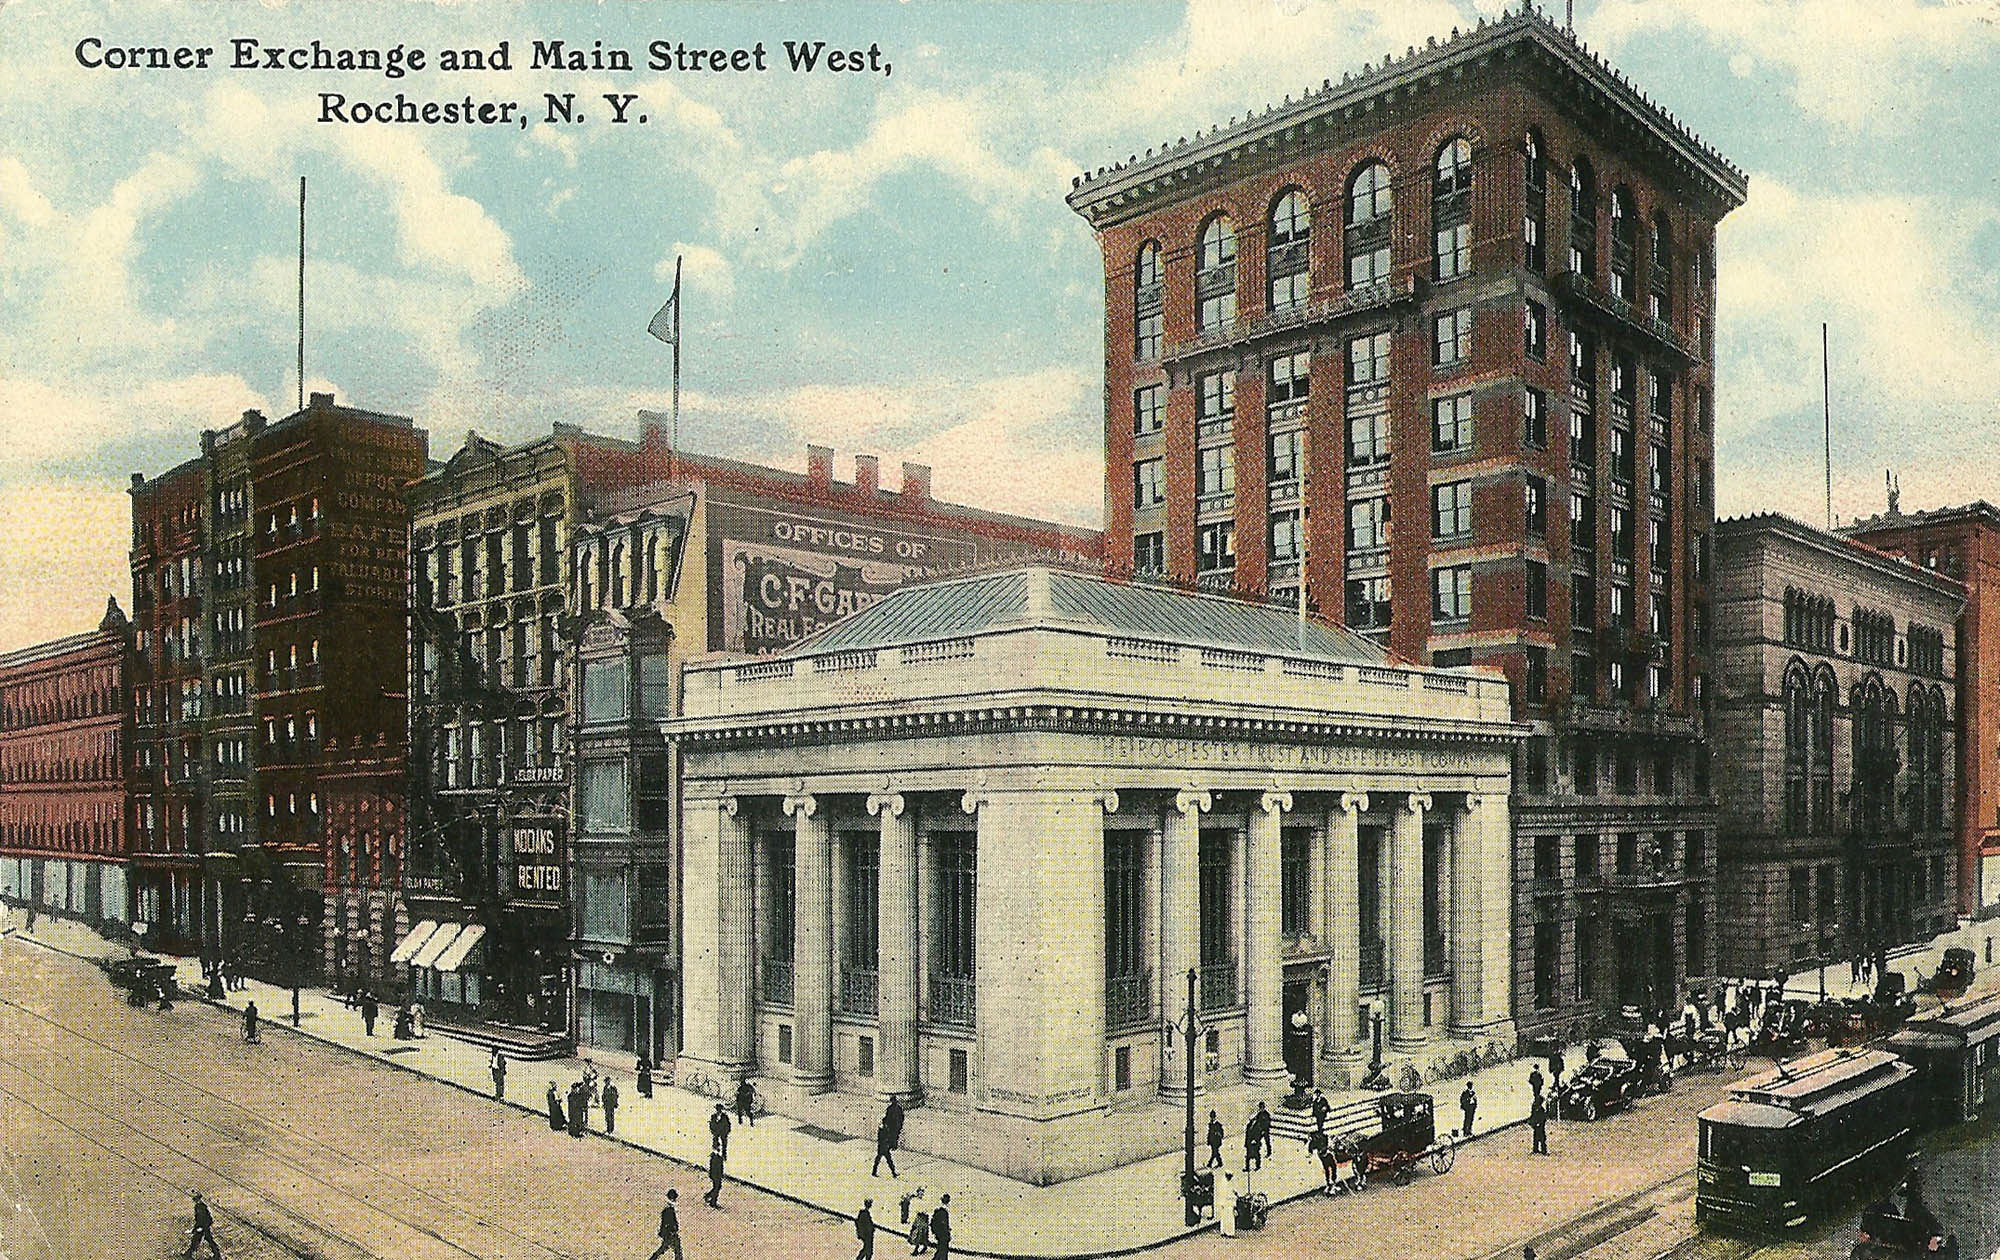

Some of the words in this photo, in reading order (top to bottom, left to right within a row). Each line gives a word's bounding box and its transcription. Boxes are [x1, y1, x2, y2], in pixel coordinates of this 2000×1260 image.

[774, 521, 885, 554] OFFICES
[895, 541, 928, 560] OF
[750, 604, 799, 641] REAL
[1138, 739, 1241, 763] ROCHESTER
[537, 768, 564, 782] PAPER
[513, 828, 555, 855] KODAKS
[518, 864, 561, 891] RENTED
